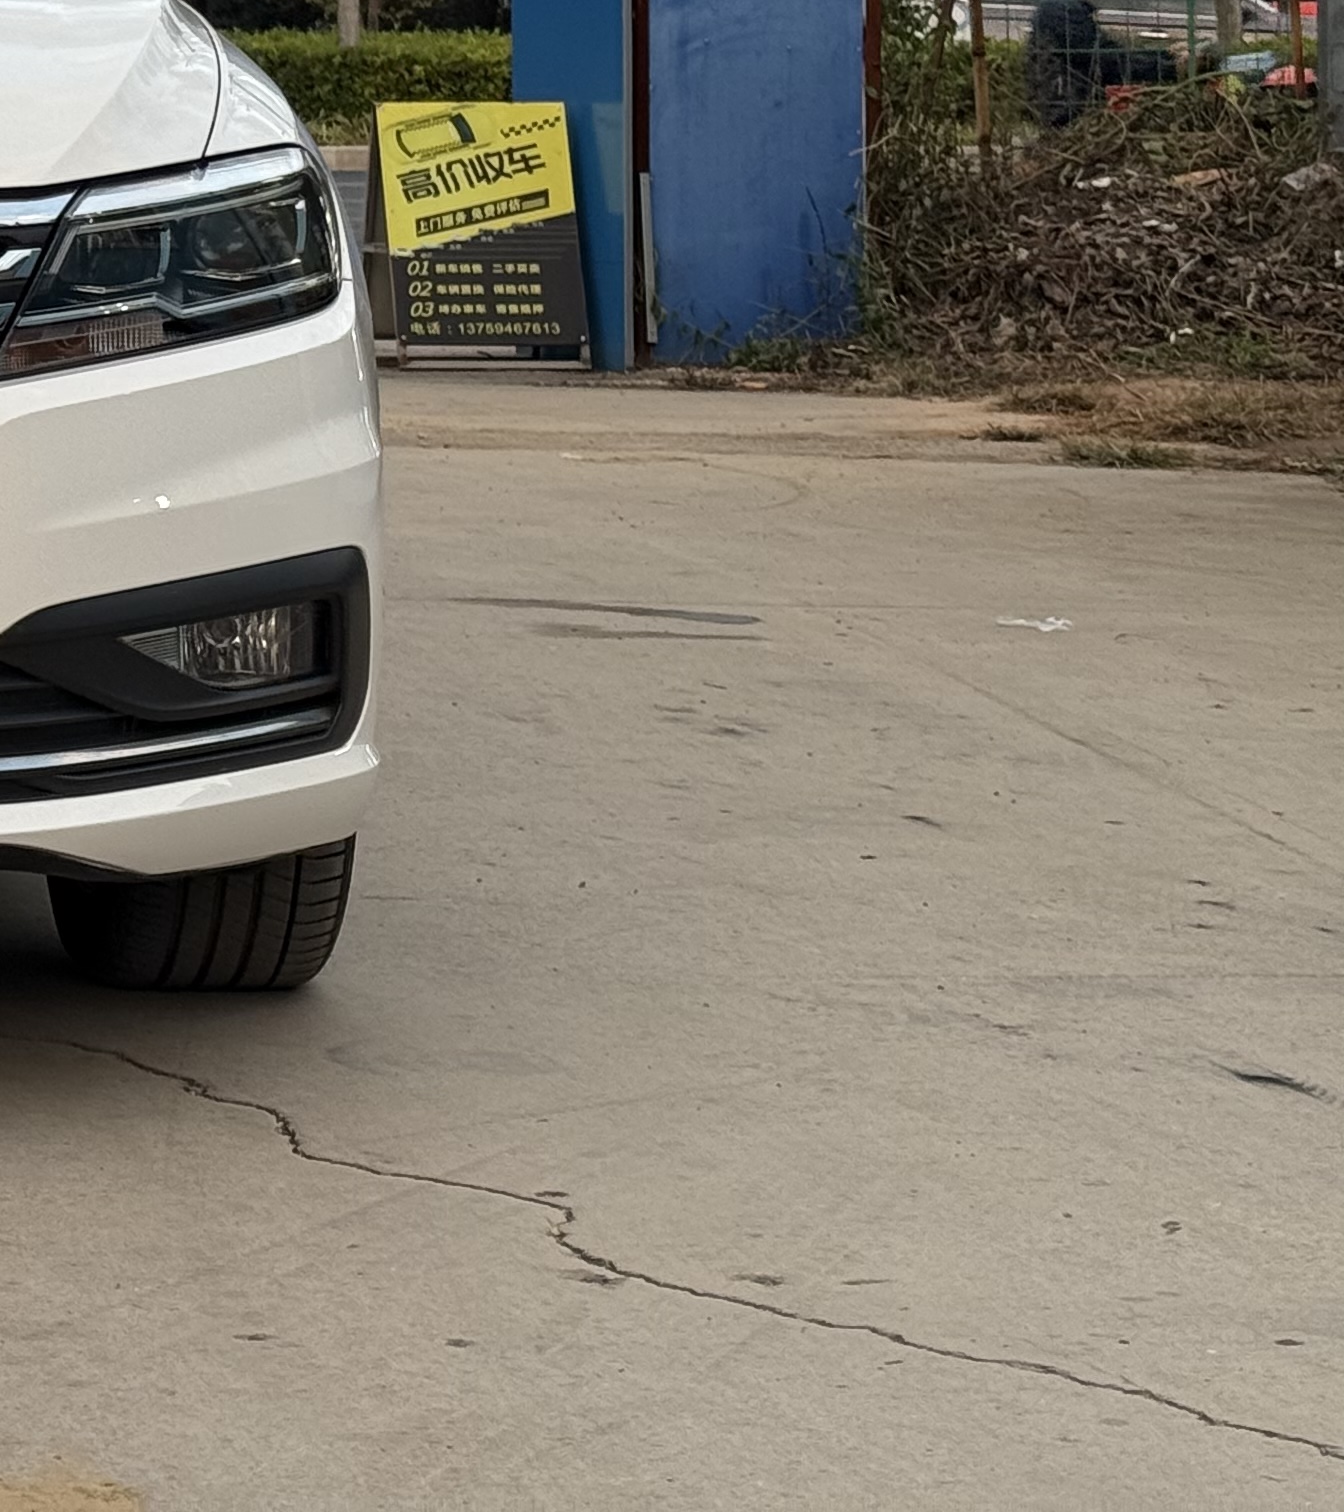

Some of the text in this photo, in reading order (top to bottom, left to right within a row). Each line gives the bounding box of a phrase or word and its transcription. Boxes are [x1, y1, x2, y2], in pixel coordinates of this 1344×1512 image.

[396, 143, 547, 204] 高价收车
[417, 198, 522, 235] 上门服务 免费评估
[407, 260, 430, 277] 01
[408, 281, 433, 297] 02
[410, 301, 434, 317] 03
